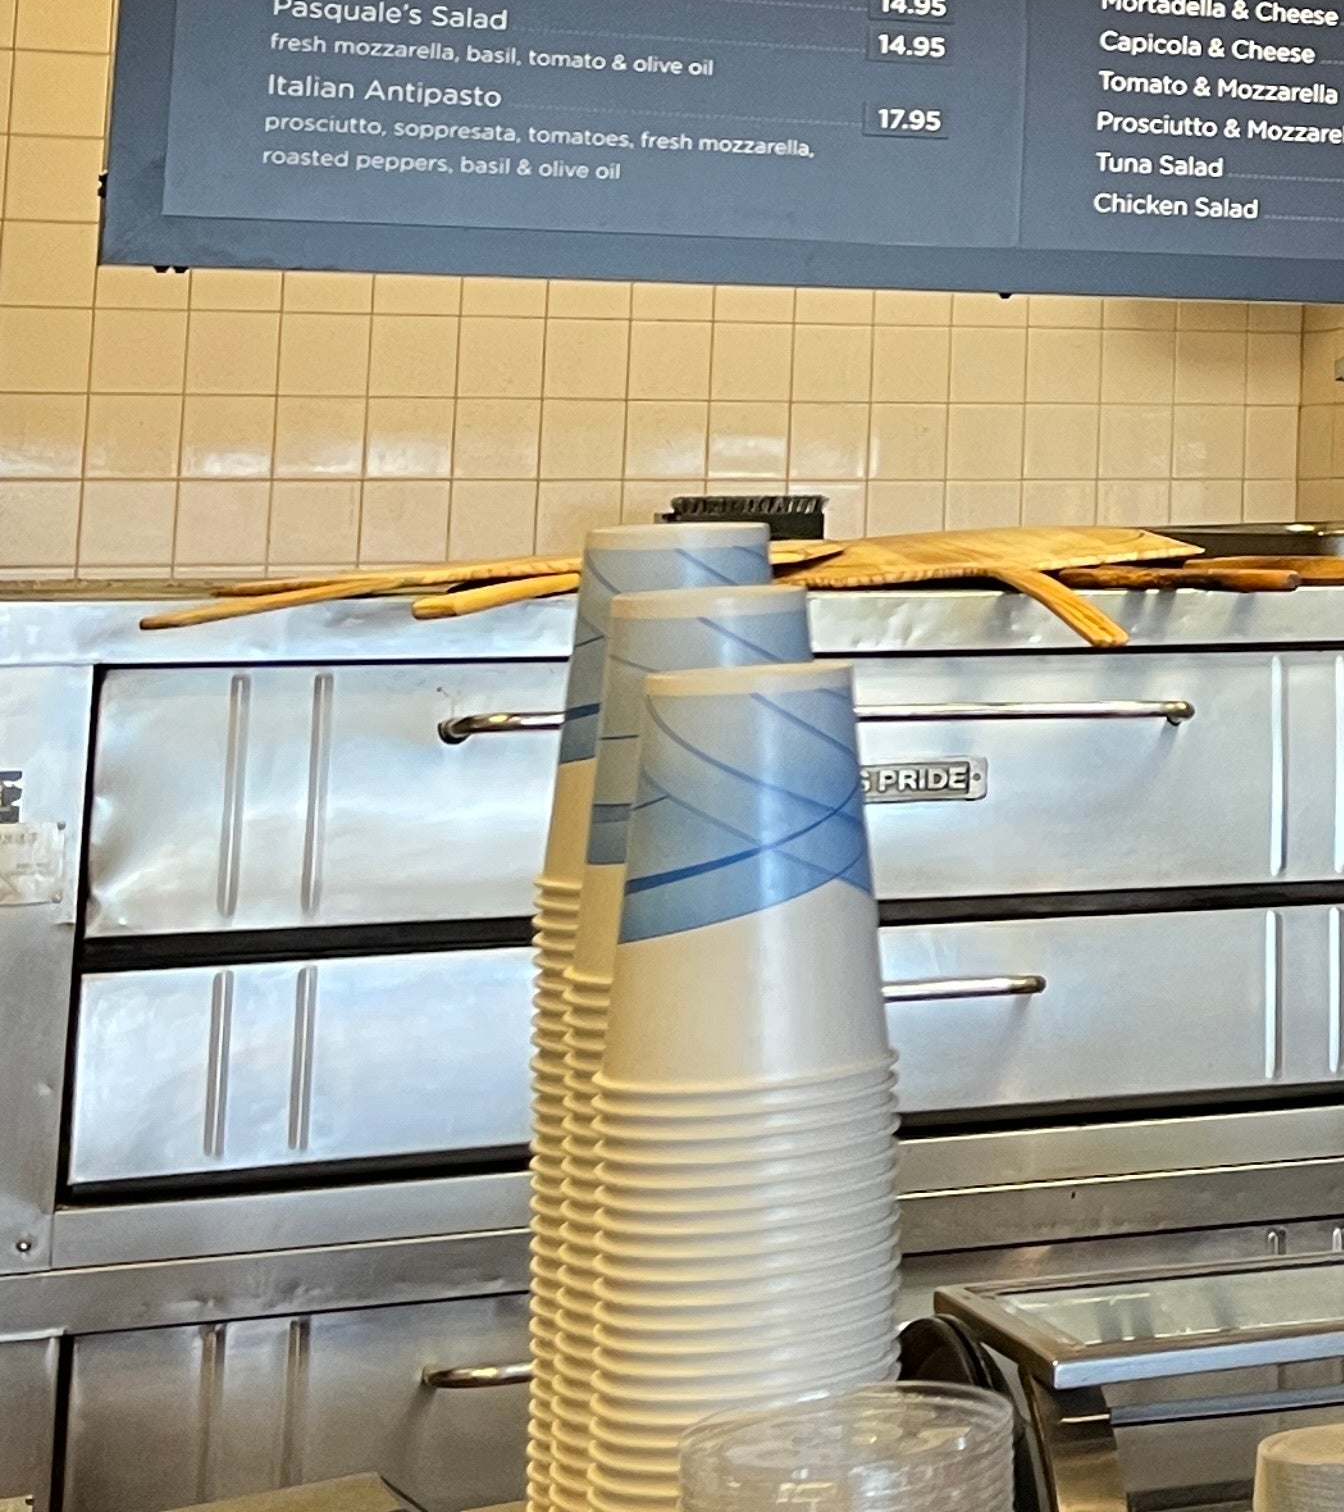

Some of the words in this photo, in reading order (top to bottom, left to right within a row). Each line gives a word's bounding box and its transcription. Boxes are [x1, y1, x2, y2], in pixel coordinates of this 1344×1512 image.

[431, 6, 507, 30] Salad
[879, 34, 945, 57] 14.95
[269, 74, 354, 99] Italian
[364, 80, 501, 107] Antipasto
[879, 109, 940, 131] 17.95
[878, 766, 968, 792] PRIDE
